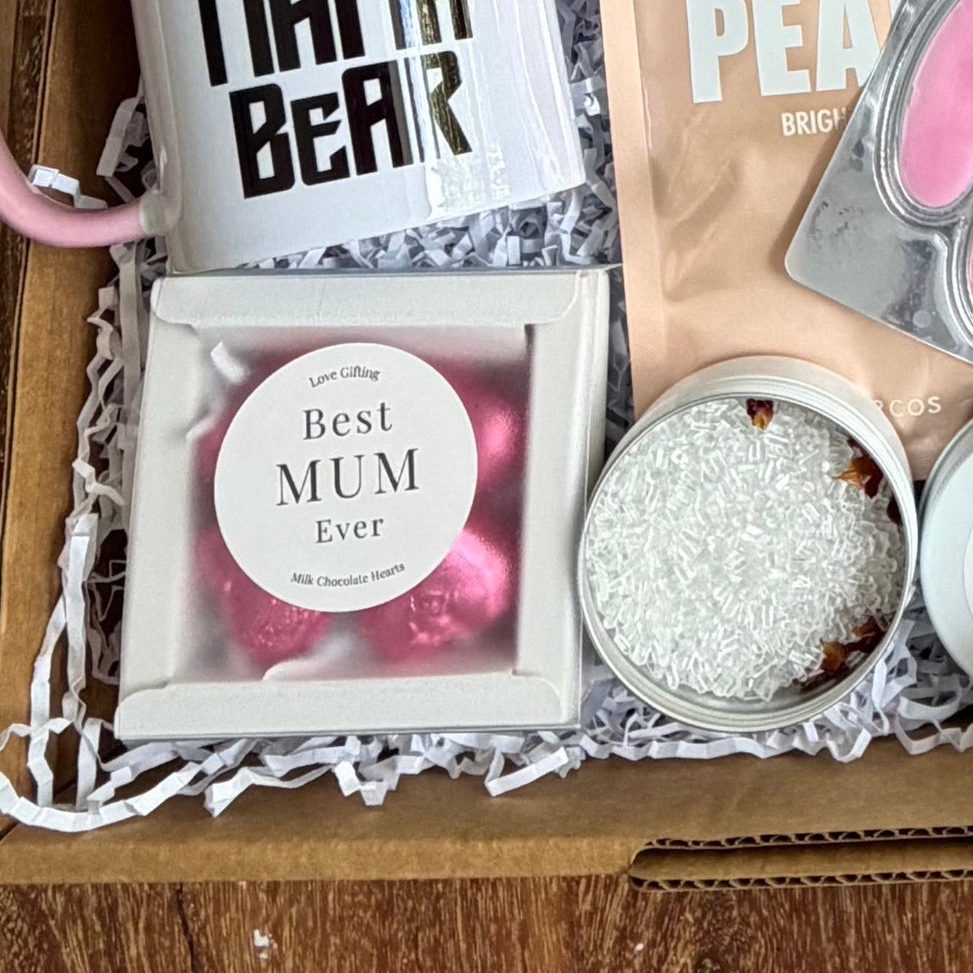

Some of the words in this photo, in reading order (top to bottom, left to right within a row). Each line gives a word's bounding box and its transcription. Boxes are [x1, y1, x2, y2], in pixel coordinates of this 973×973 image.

[229, 50, 473, 199] BEAR
[309, 368, 337, 388] Love
[340, 365, 380, 381] Gifting
[303, 402, 392, 440] Best
[276, 448, 419, 506] MUM
[315, 518, 384, 543] Ever
[290, 571, 314, 585] Milk
[316, 574, 368, 586] Chocolate
[371, 563, 405, 581] Hearts
